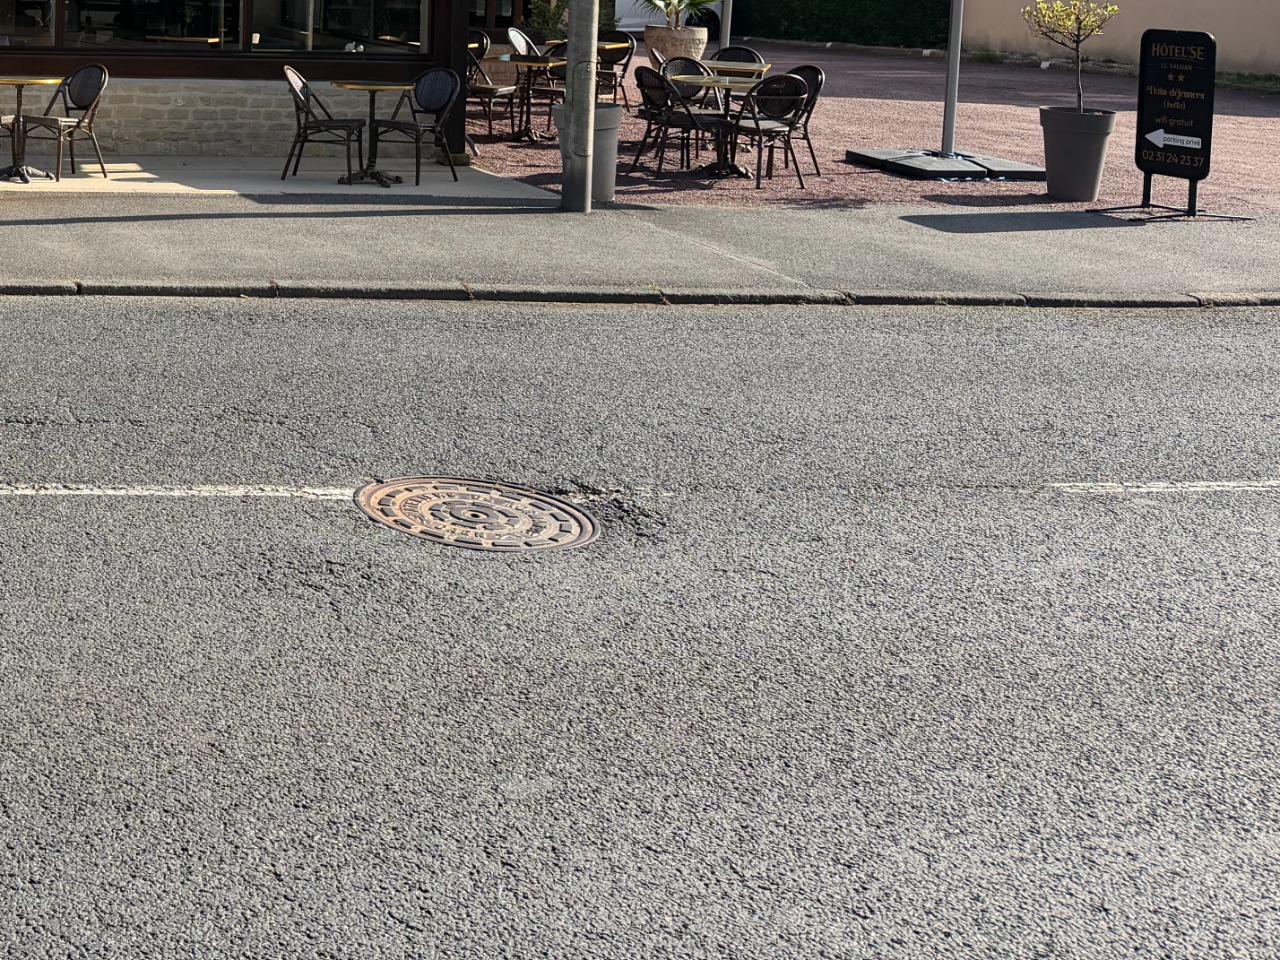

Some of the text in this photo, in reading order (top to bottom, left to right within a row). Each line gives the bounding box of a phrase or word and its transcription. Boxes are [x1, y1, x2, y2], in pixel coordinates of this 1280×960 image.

[1163, 136, 1184, 145] parking
[1142, 150, 1154, 160] 02
[1155, 151, 1165, 161] 31
[1166, 153, 1178, 163] 24
[1193, 157, 1205, 167] 37
